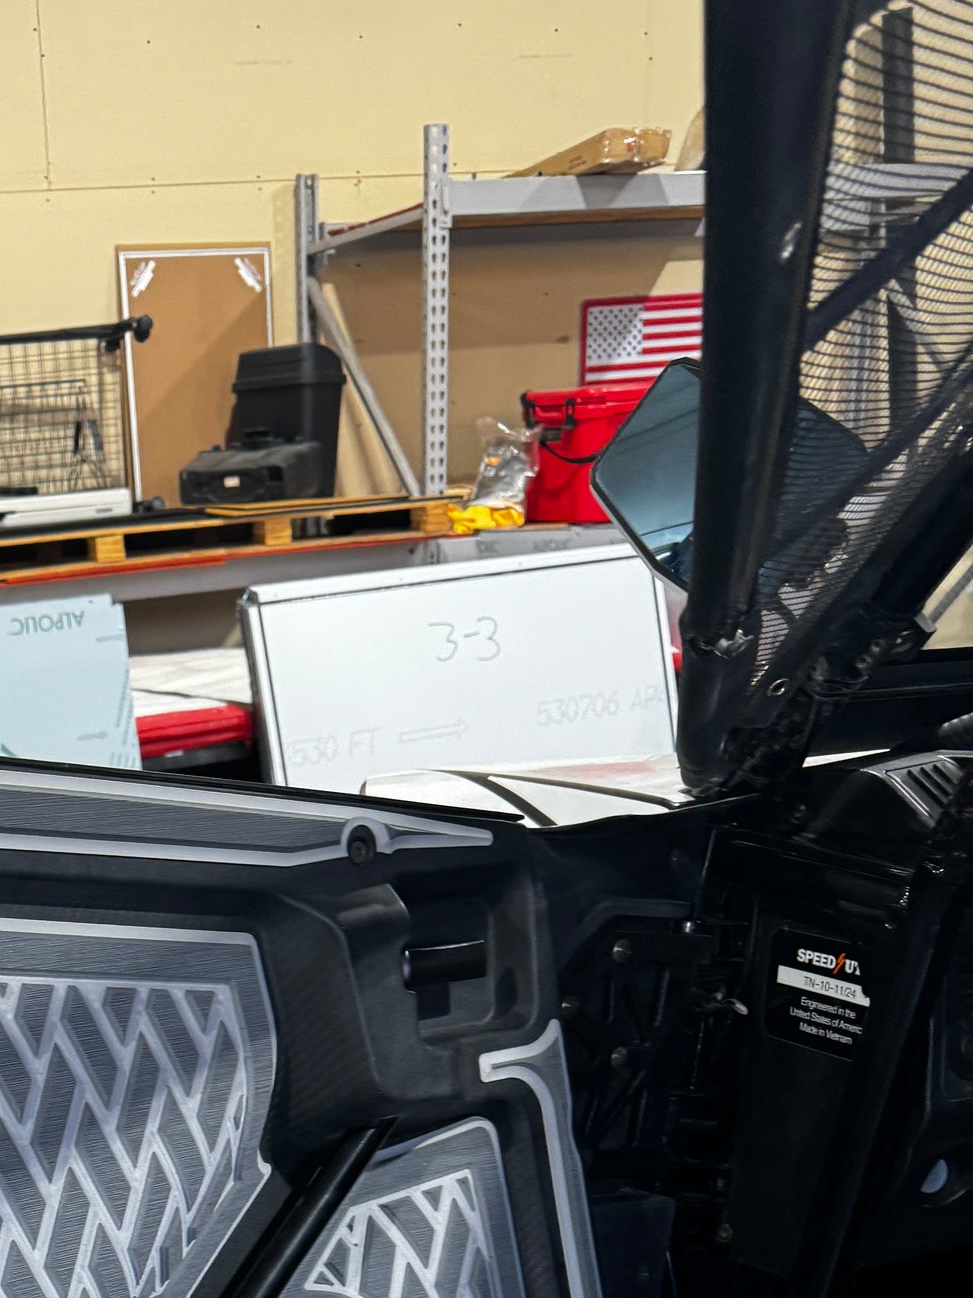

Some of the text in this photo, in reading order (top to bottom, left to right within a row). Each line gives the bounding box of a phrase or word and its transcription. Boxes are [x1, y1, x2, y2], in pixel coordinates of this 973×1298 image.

[6, 611, 85, 636] ALPOLIC
[427, 616, 501, 662] 3-3
[796, 948, 836, 969] SPEED
[801, 996, 837, 1014] Engineered
[845, 1008, 856, 1019] the
[790, 1006, 810, 1020] United
[811, 1012, 831, 1025] States
[839, 1020, 863, 1034] Americ
[799, 1022, 818, 1035] Made
[826, 1029, 853, 1045] Vietnam
